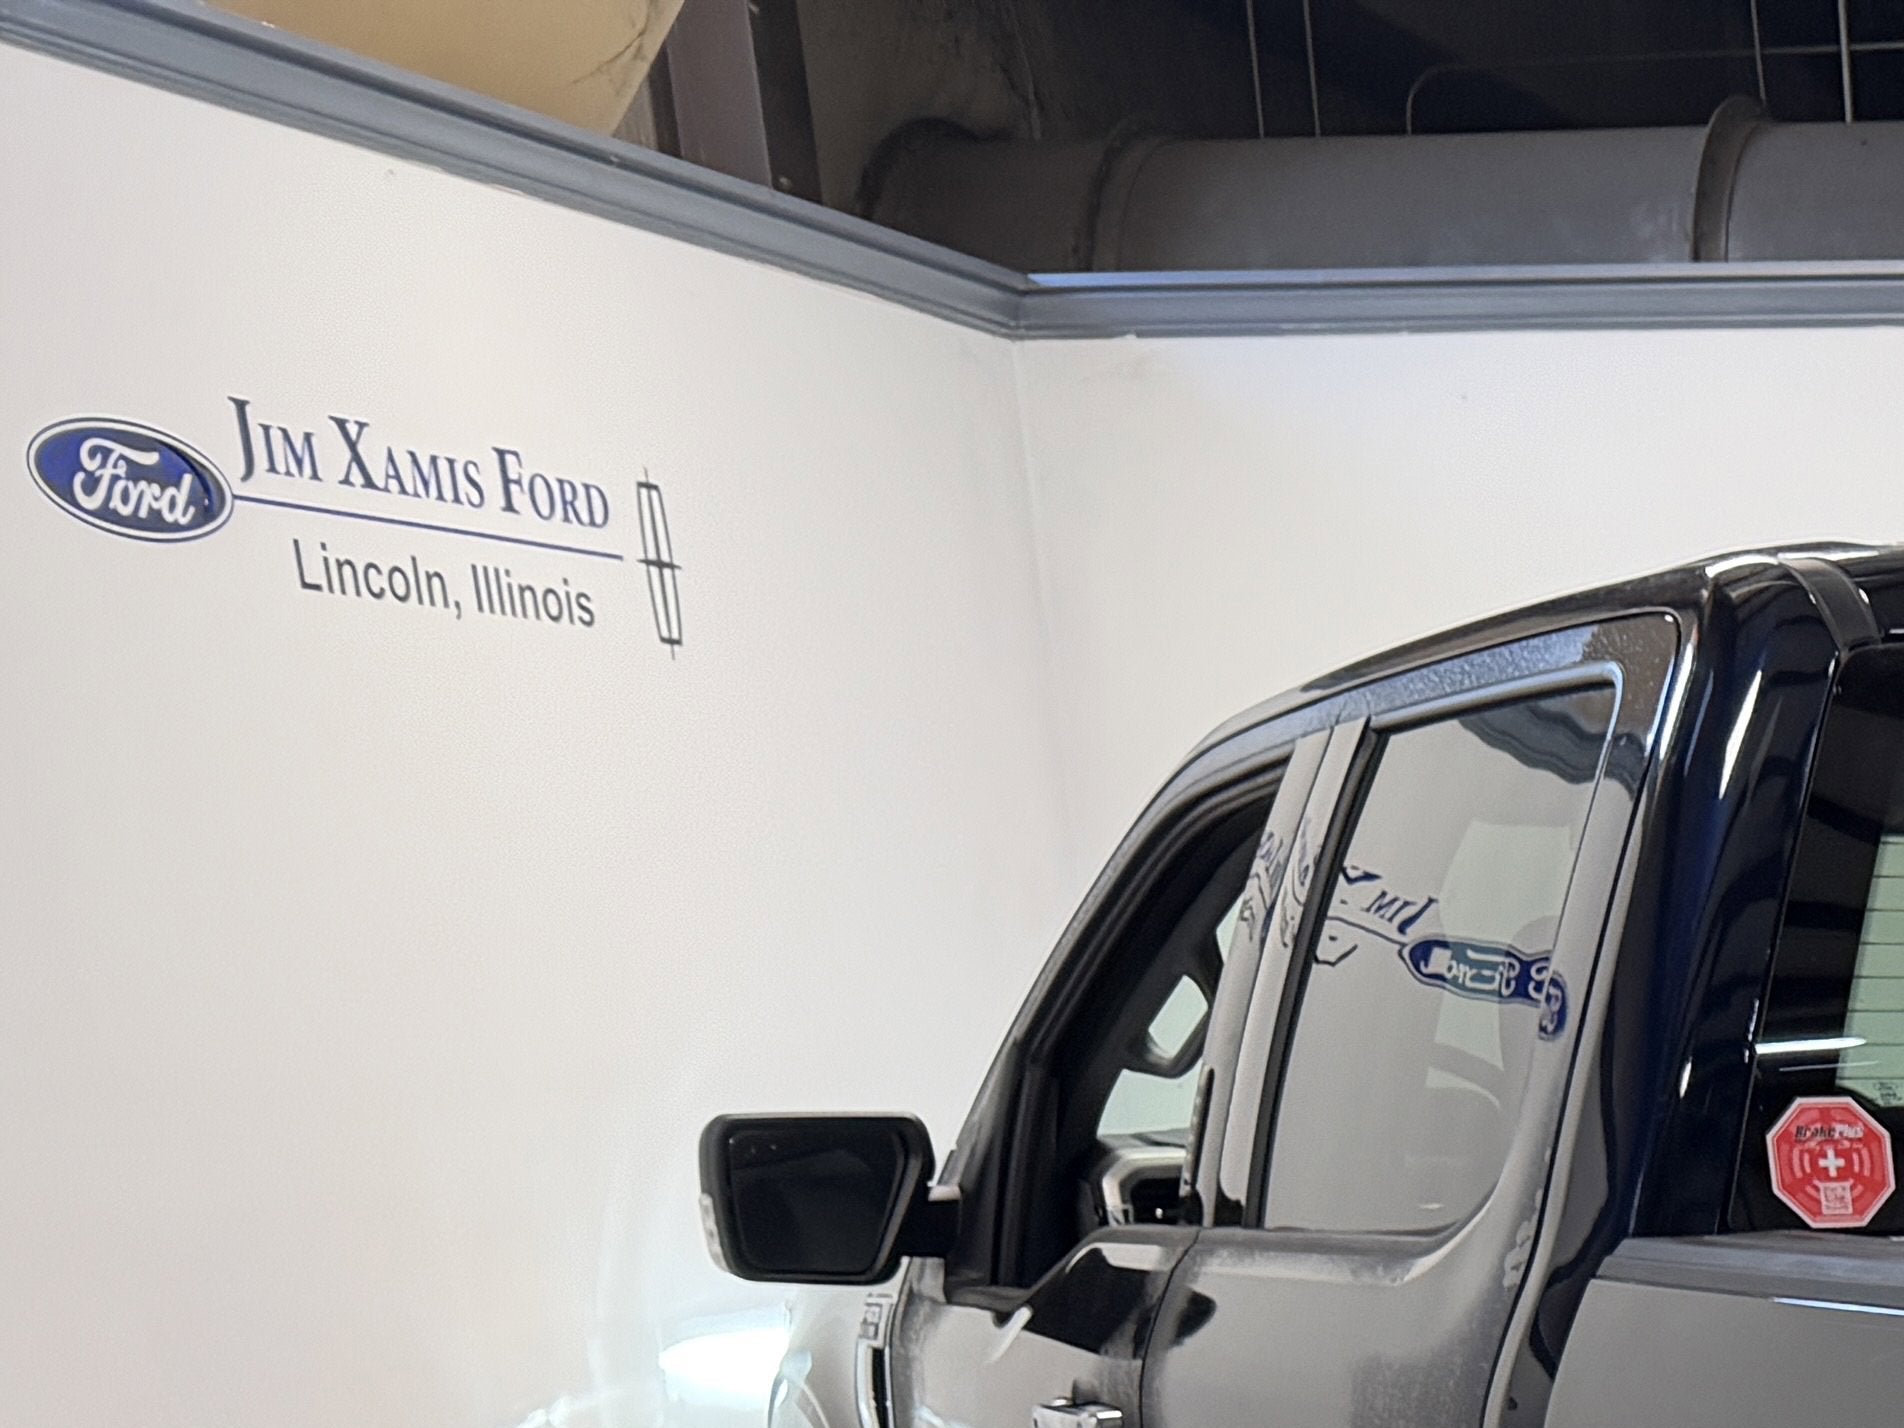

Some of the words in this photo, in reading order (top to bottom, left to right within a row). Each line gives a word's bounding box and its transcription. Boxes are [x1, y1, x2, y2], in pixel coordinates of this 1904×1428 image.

[74, 437, 196, 527] Ford
[227, 395, 323, 484] JIM
[328, 414, 485, 509] XAMIS
[492, 445, 610, 530] FORD
[292, 538, 463, 620] Lincoln,
[470, 562, 595, 628] Illinois
